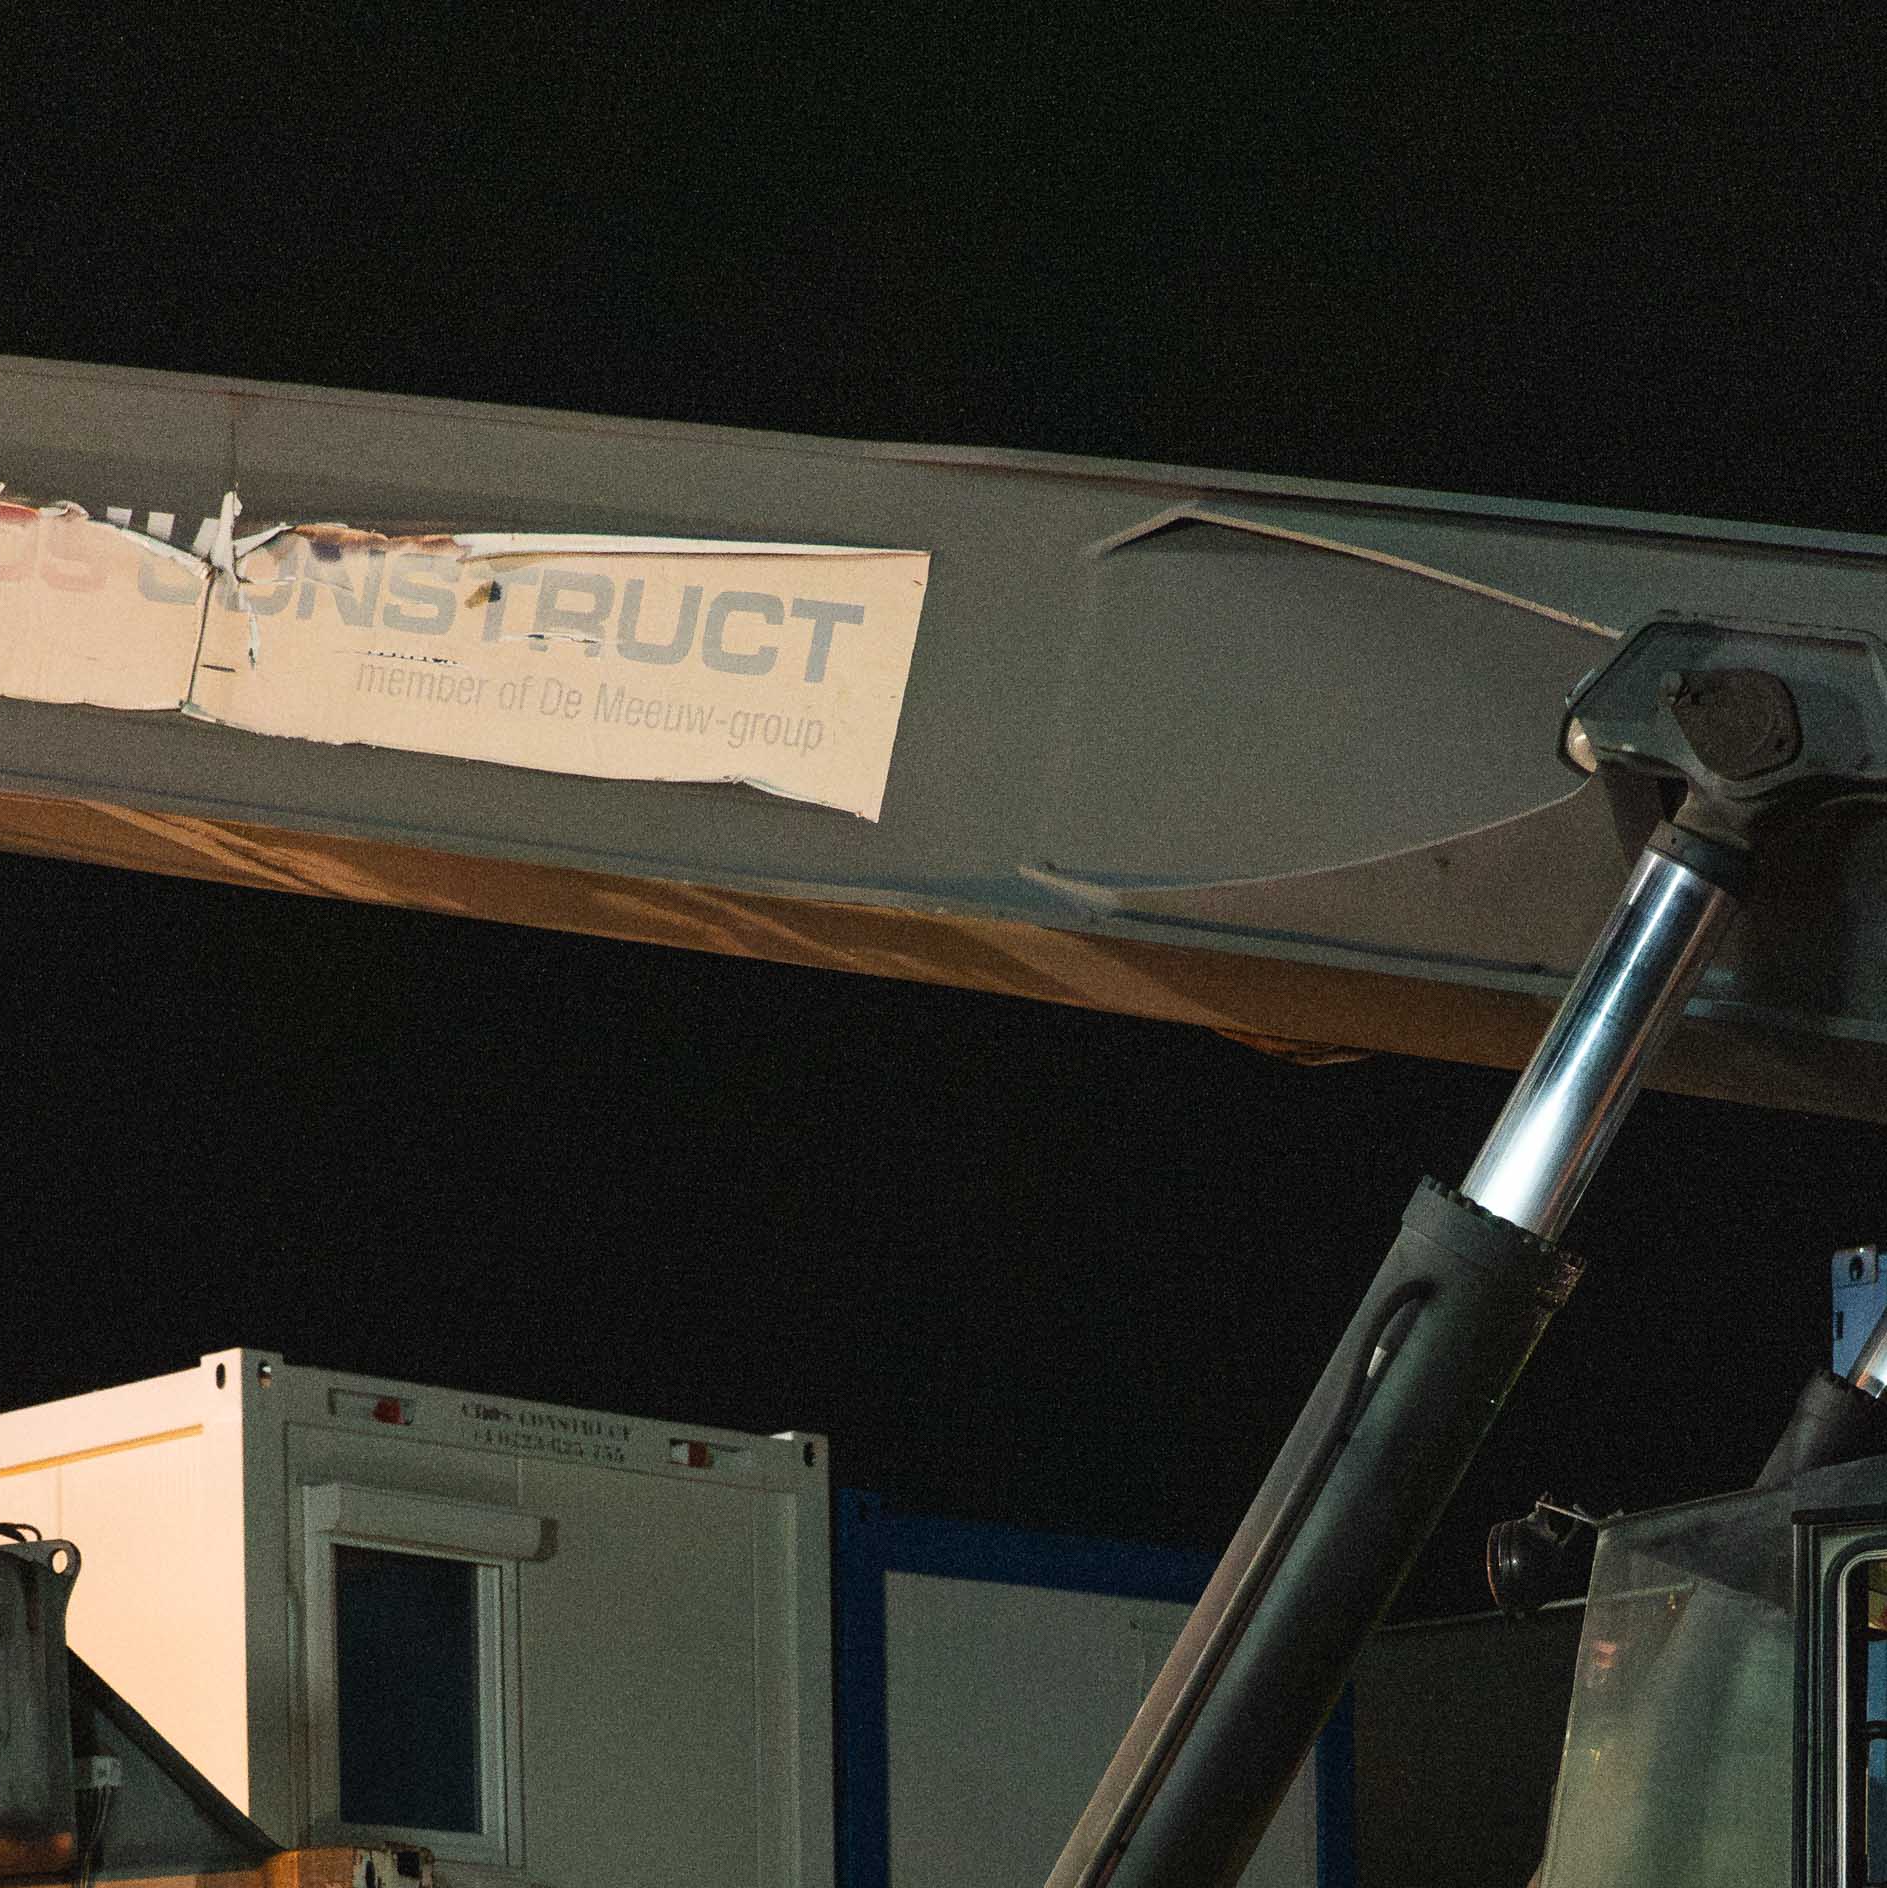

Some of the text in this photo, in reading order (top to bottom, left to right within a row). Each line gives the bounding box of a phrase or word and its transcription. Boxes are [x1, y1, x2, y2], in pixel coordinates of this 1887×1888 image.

[354, 661, 825, 754] member of De Meeuw-group
